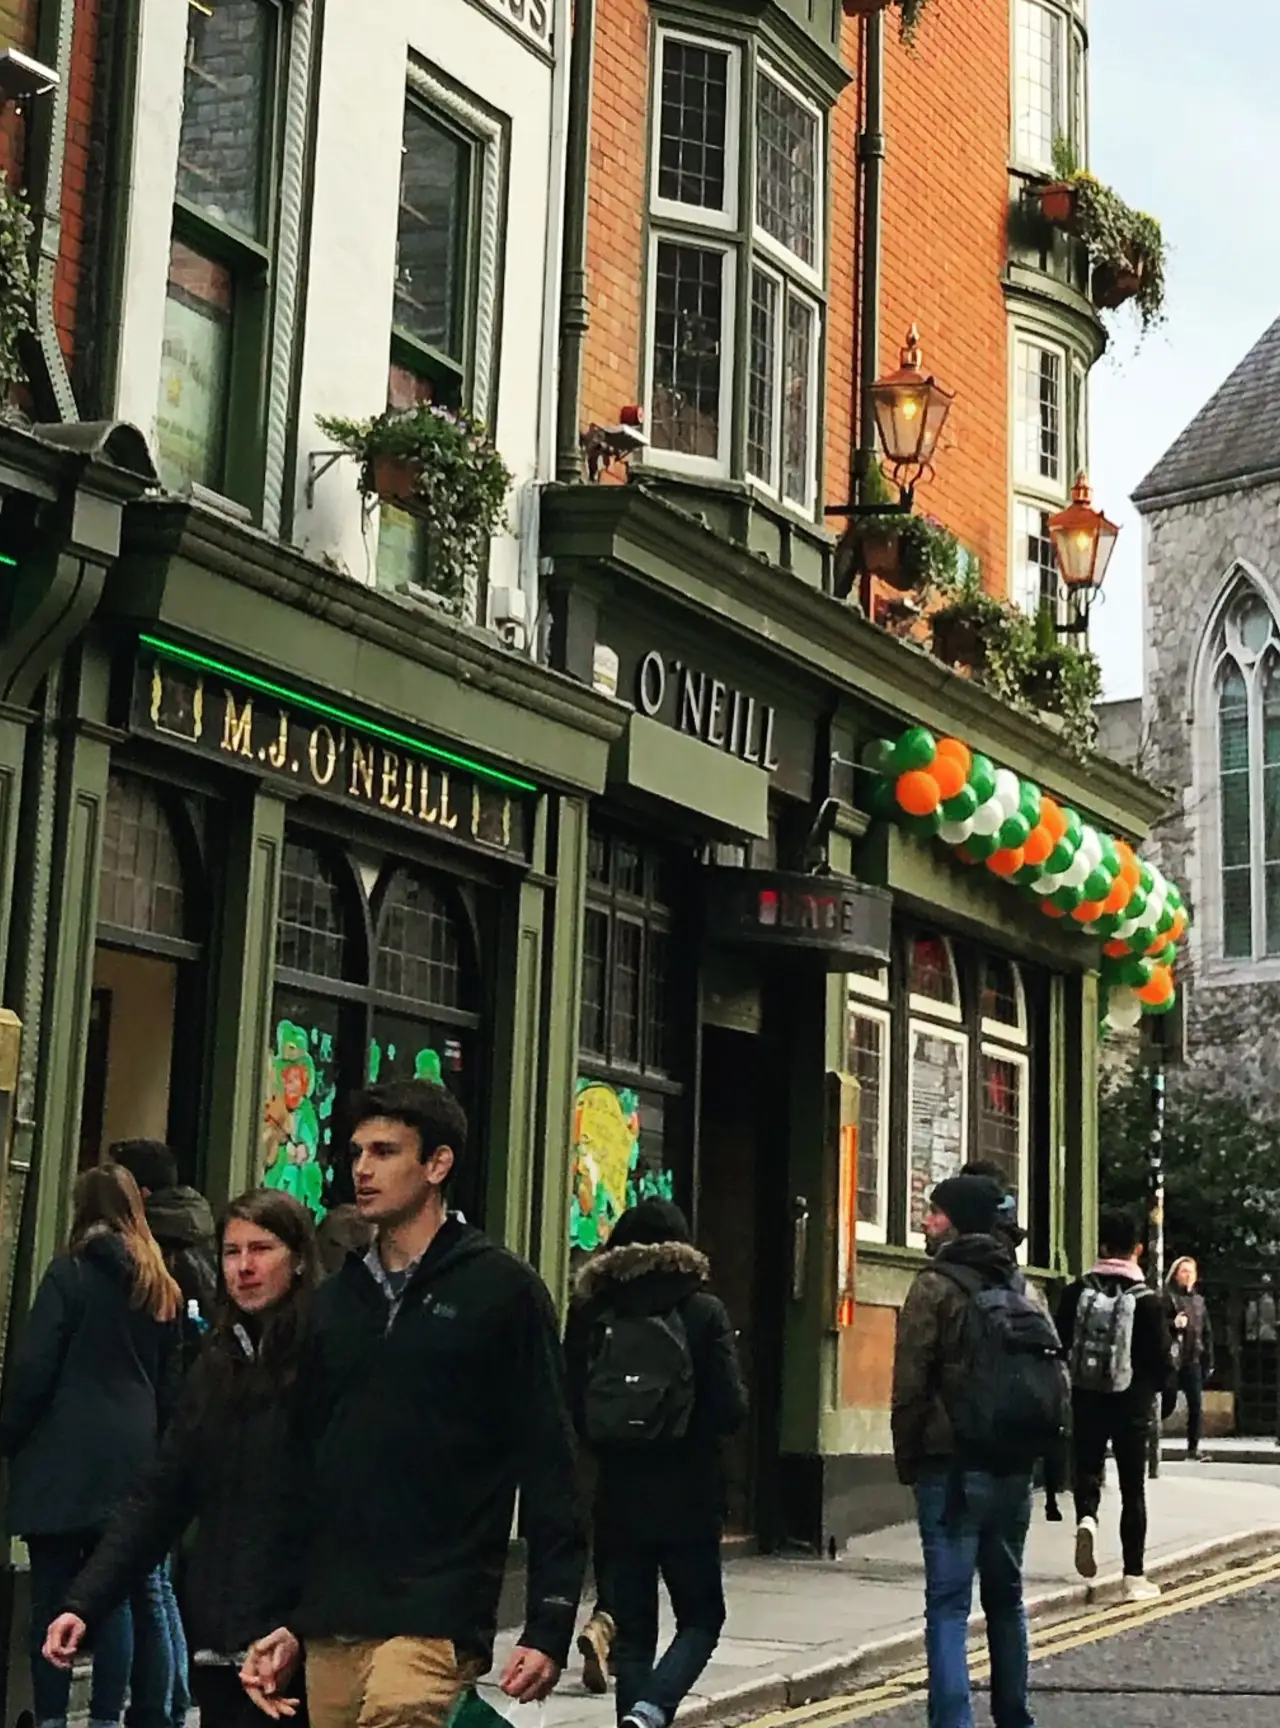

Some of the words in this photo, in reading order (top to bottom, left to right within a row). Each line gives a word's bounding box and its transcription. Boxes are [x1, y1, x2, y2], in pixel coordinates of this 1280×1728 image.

[220, 687, 299, 773] M.J.
[309, 723, 458, 829] O'NEILL
[640, 650, 780, 772] O'NEILL
